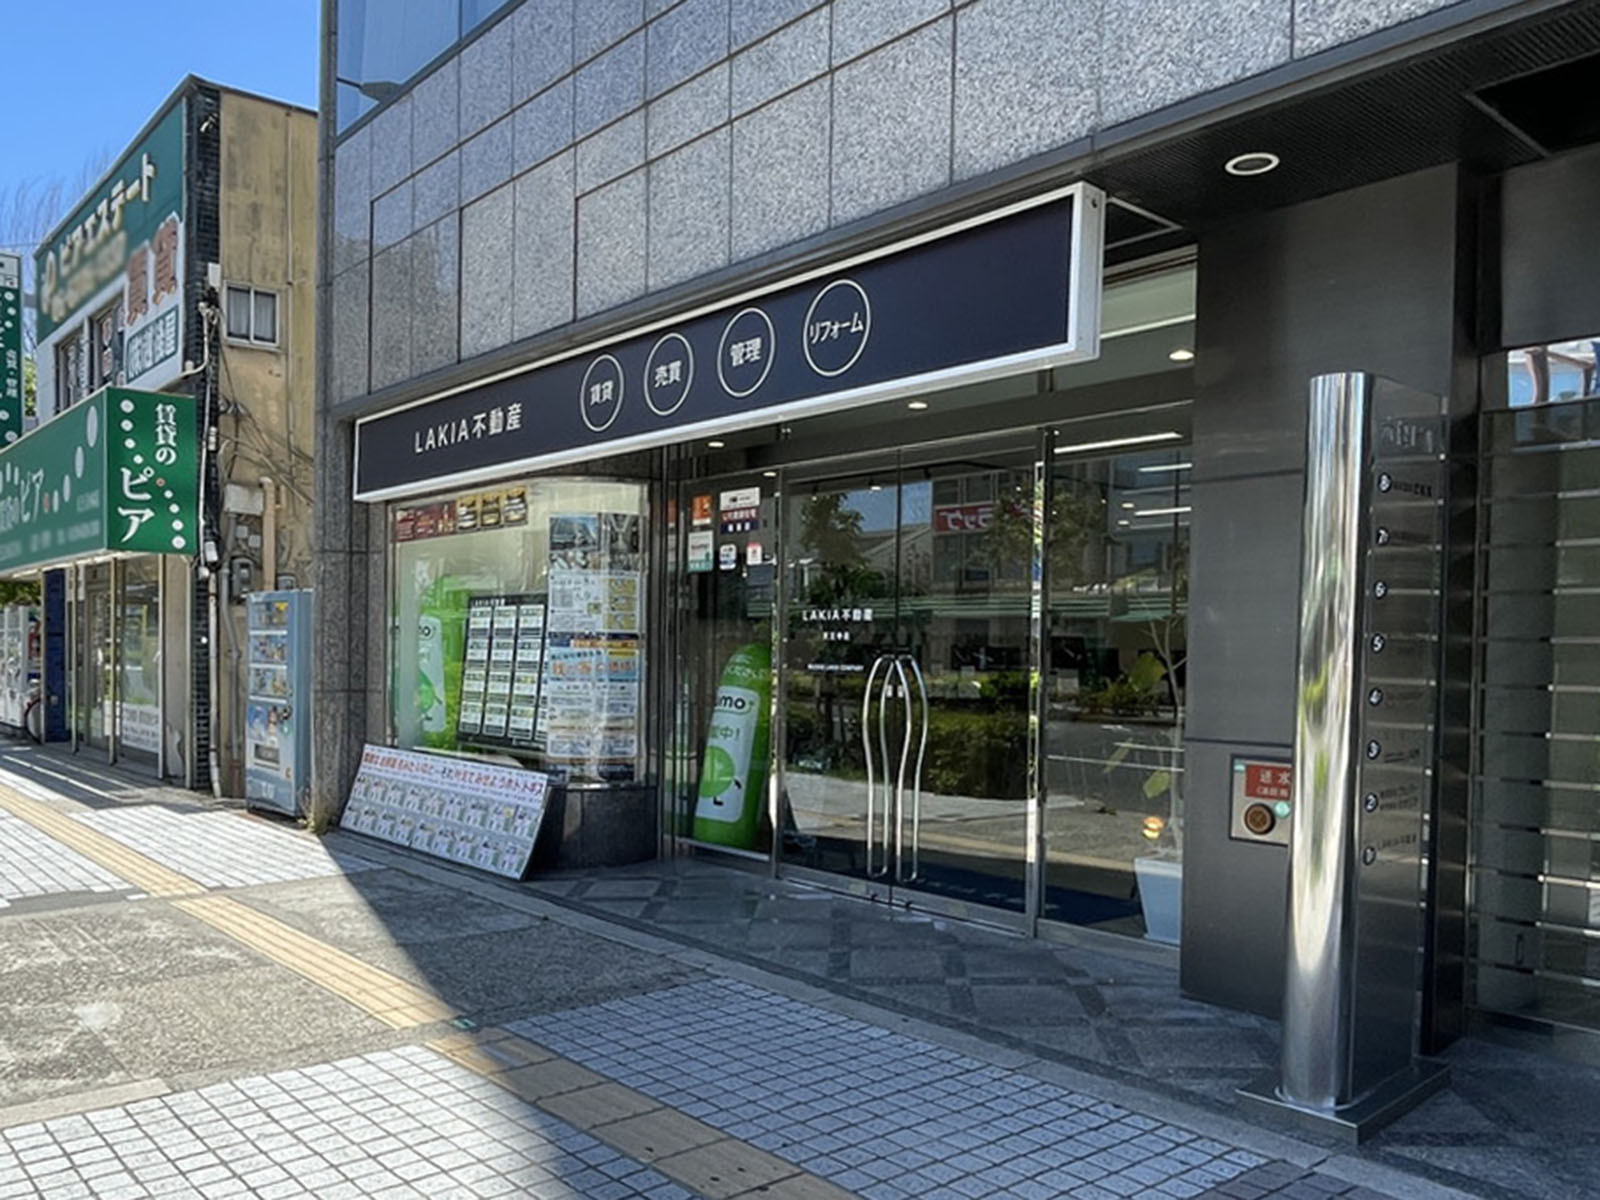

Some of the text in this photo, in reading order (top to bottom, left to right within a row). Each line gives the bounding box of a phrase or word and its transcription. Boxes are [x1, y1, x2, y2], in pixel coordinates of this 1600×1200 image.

[809, 311, 863, 344] リフォーム
[729, 338, 762, 368] 管理
[654, 360, 682, 387] 売買
[590, 380, 613, 406] 賃貸
[155, 403, 177, 465] 賃貸の
[414, 402, 522, 453] LAKIA不動産
[117, 466, 155, 542] ピア
[714, 695, 746, 710] mo
